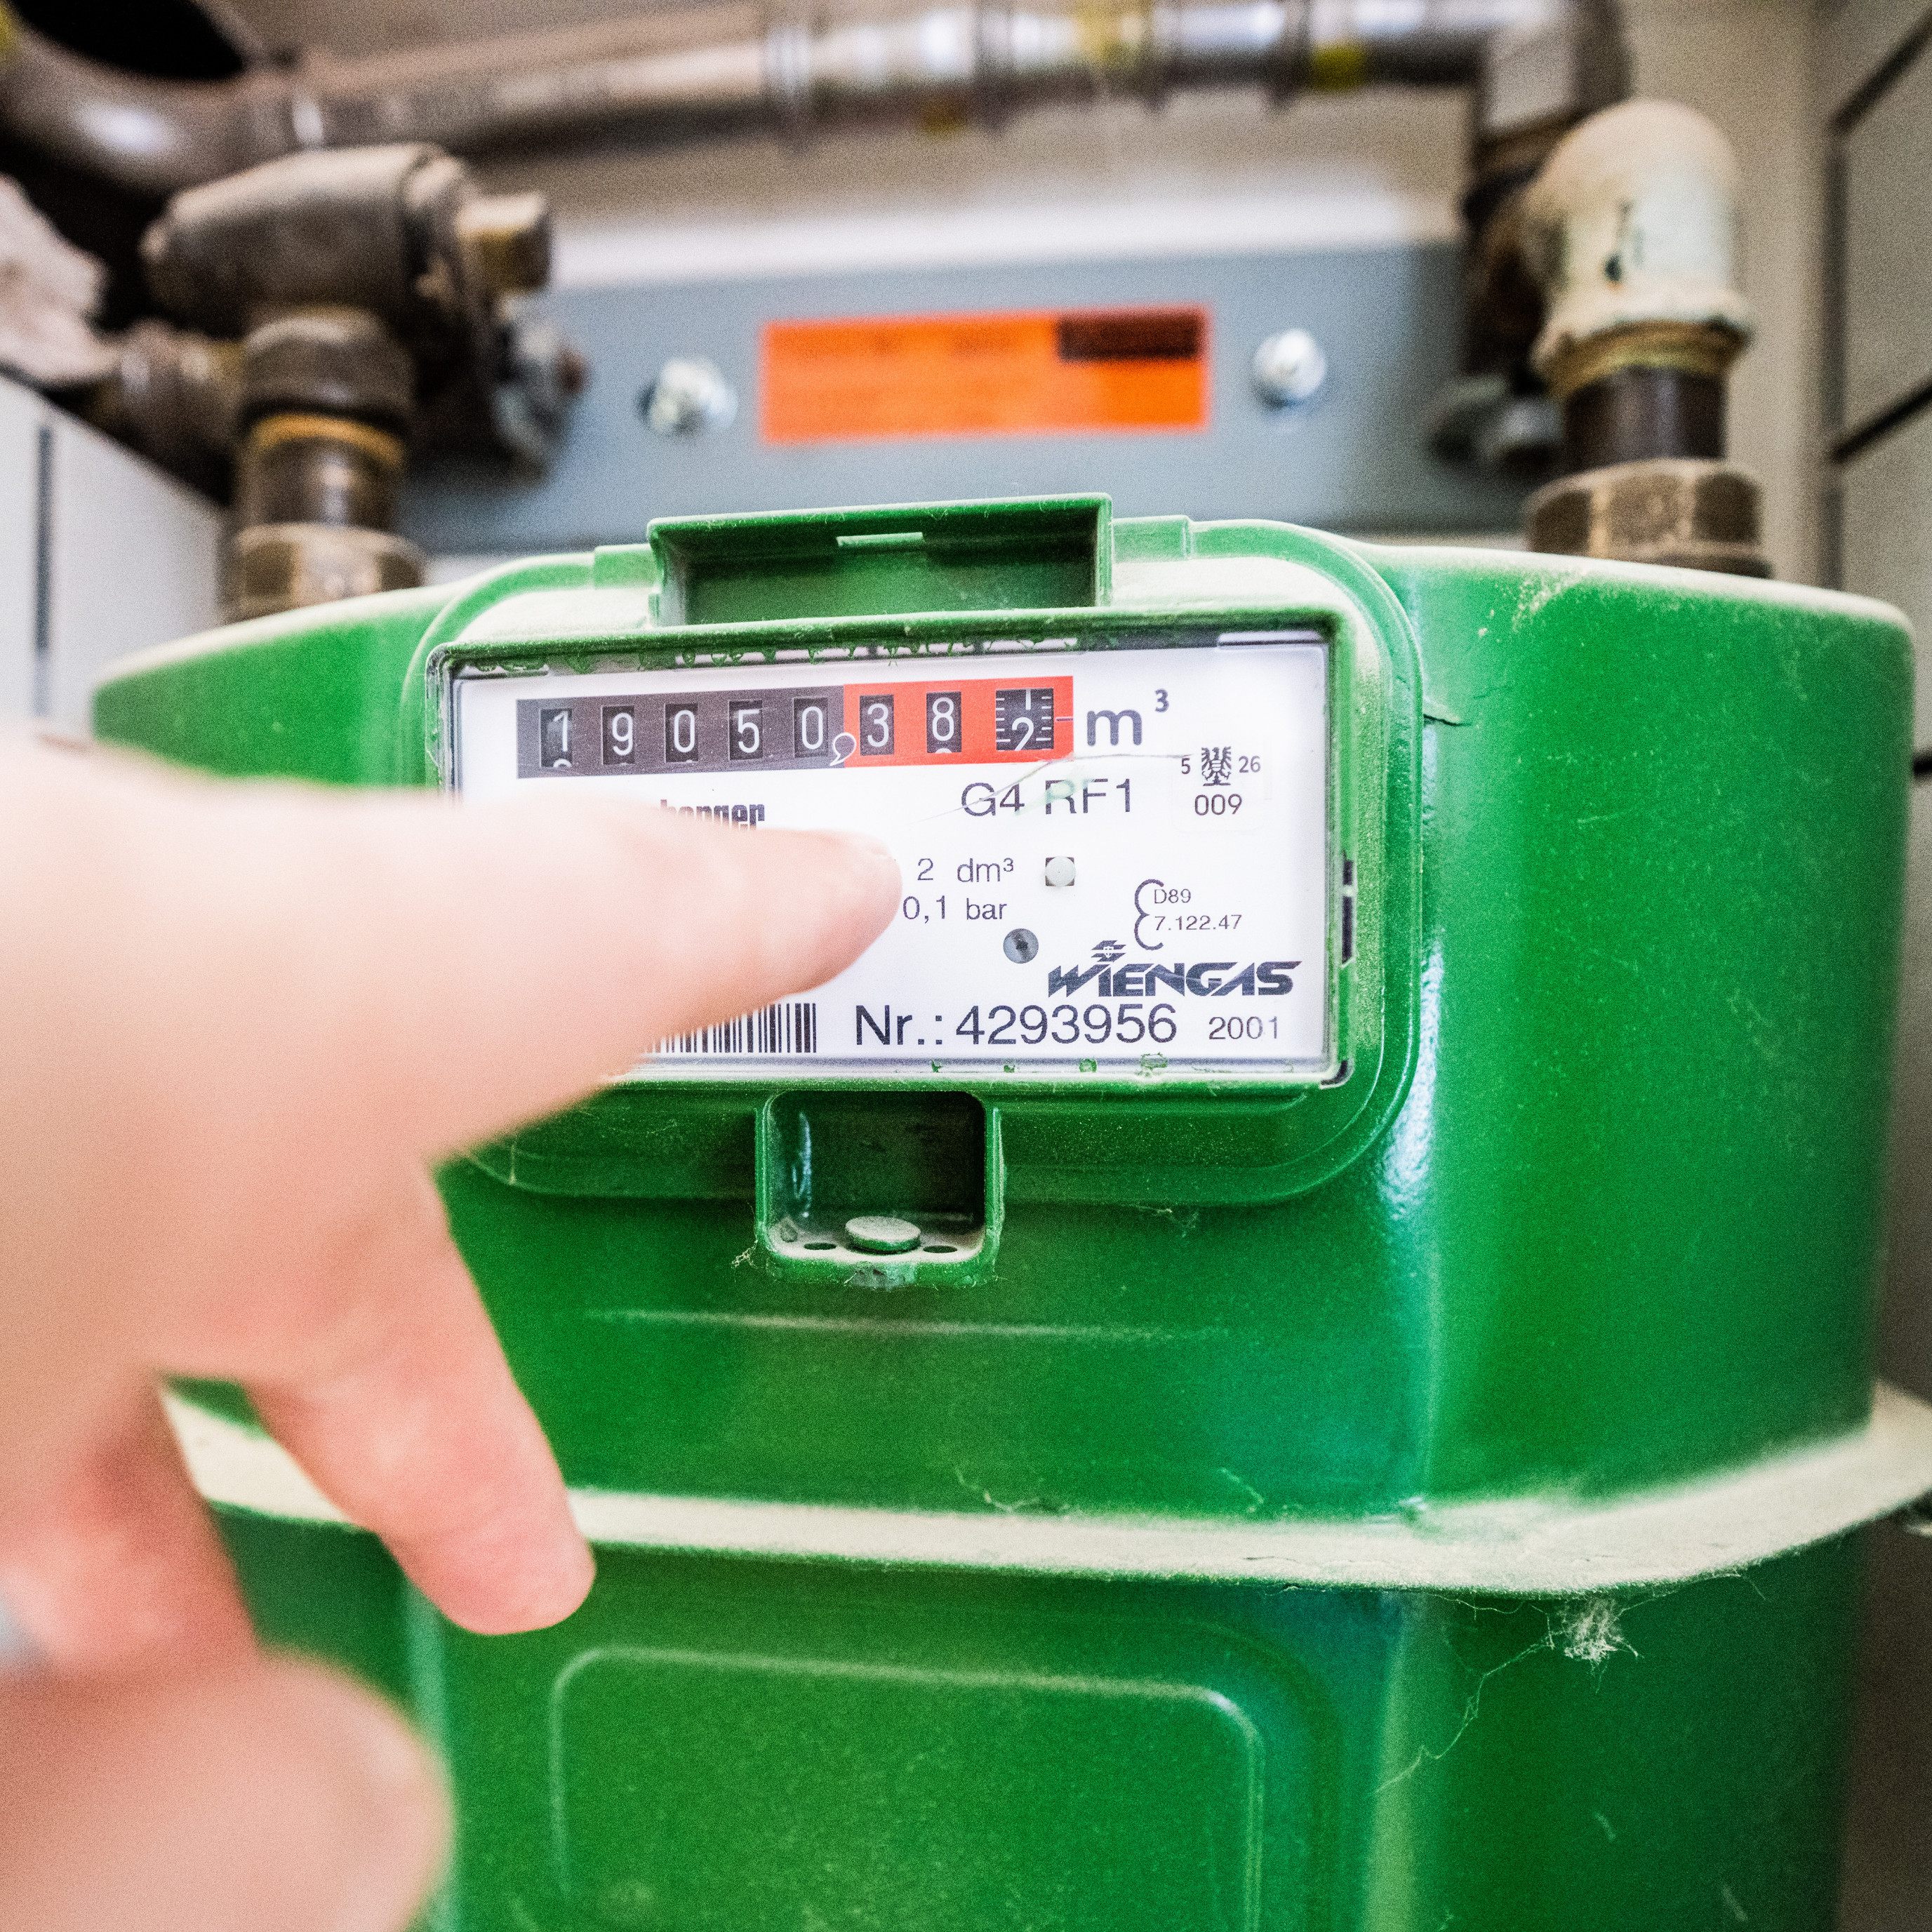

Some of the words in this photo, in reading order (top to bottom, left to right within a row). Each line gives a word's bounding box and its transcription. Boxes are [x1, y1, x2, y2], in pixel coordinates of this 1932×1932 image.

[1180, 758, 1191, 775] 5
[1239, 756, 1261, 773] 26
[961, 782, 1025, 818] G4
[1045, 778, 1132, 815] RF1
[1194, 794, 1243, 816] 009
[917, 858, 934, 881] 2
[1154, 888, 1192, 905] D89
[902, 895, 946, 924] 0,1
[966, 898, 1008, 921] bar
[1154, 914, 1242, 931] 7.122.47
[855, 1005, 943, 1046] Nr.:
[955, 1004, 1178, 1046] 4293956
[1208, 1015, 1278, 1041] 2001
